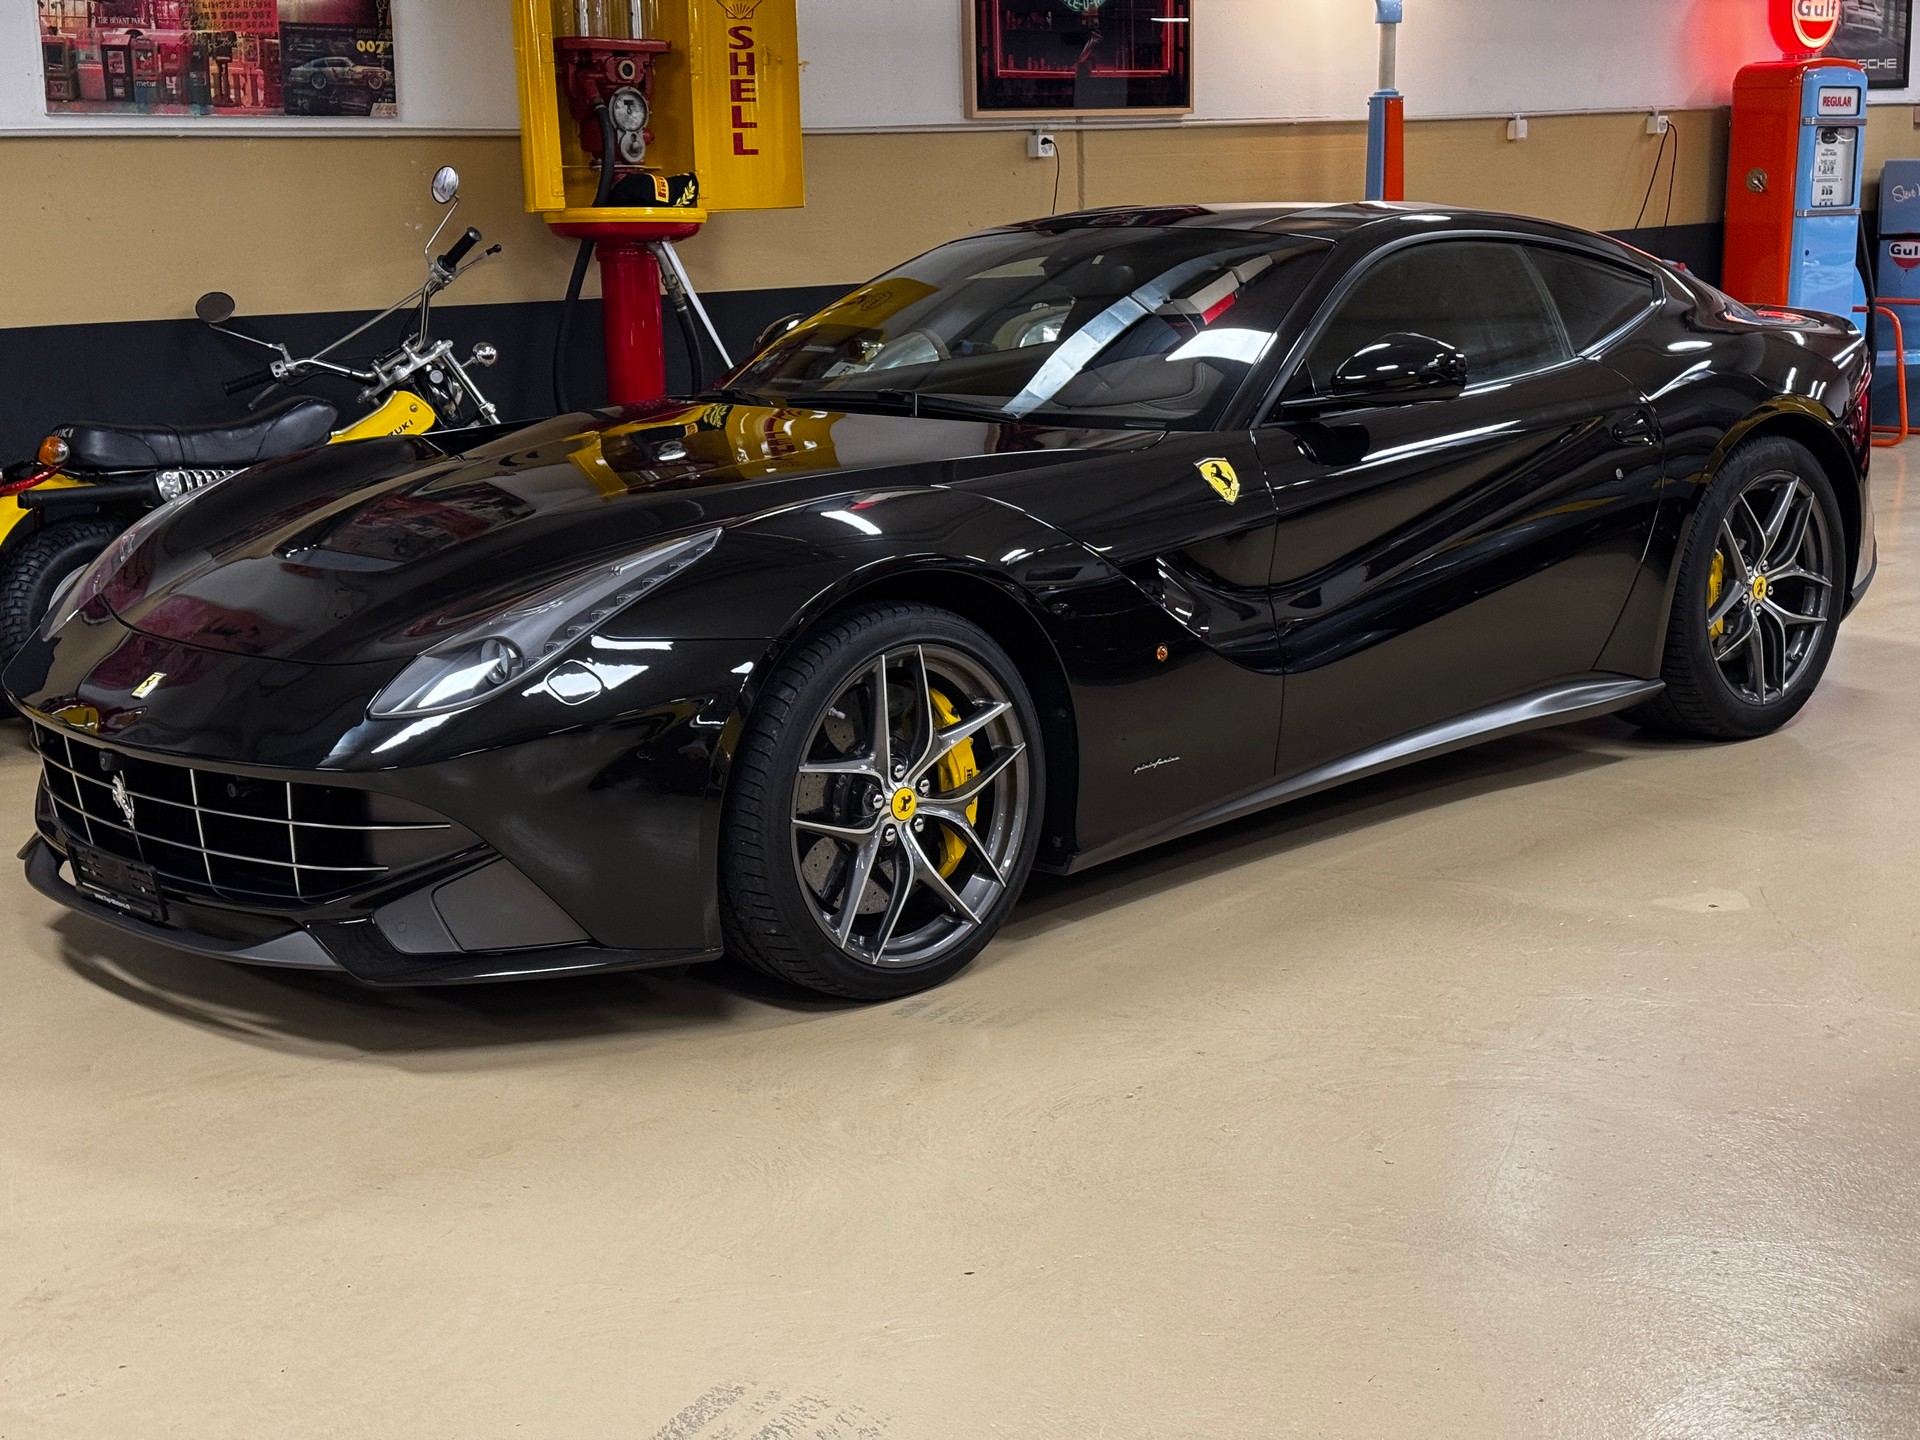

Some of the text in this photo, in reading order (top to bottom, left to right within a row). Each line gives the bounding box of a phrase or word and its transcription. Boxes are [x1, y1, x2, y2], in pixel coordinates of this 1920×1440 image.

[1797, 0, 1837, 17] Gulf
[356, 40, 386, 55] 007
[1857, 58, 1897, 69] SCHE
[728, 25, 759, 156] SHELL
[1822, 96, 1852, 108] REGULAR
[1890, 243, 1920, 256] Gul
